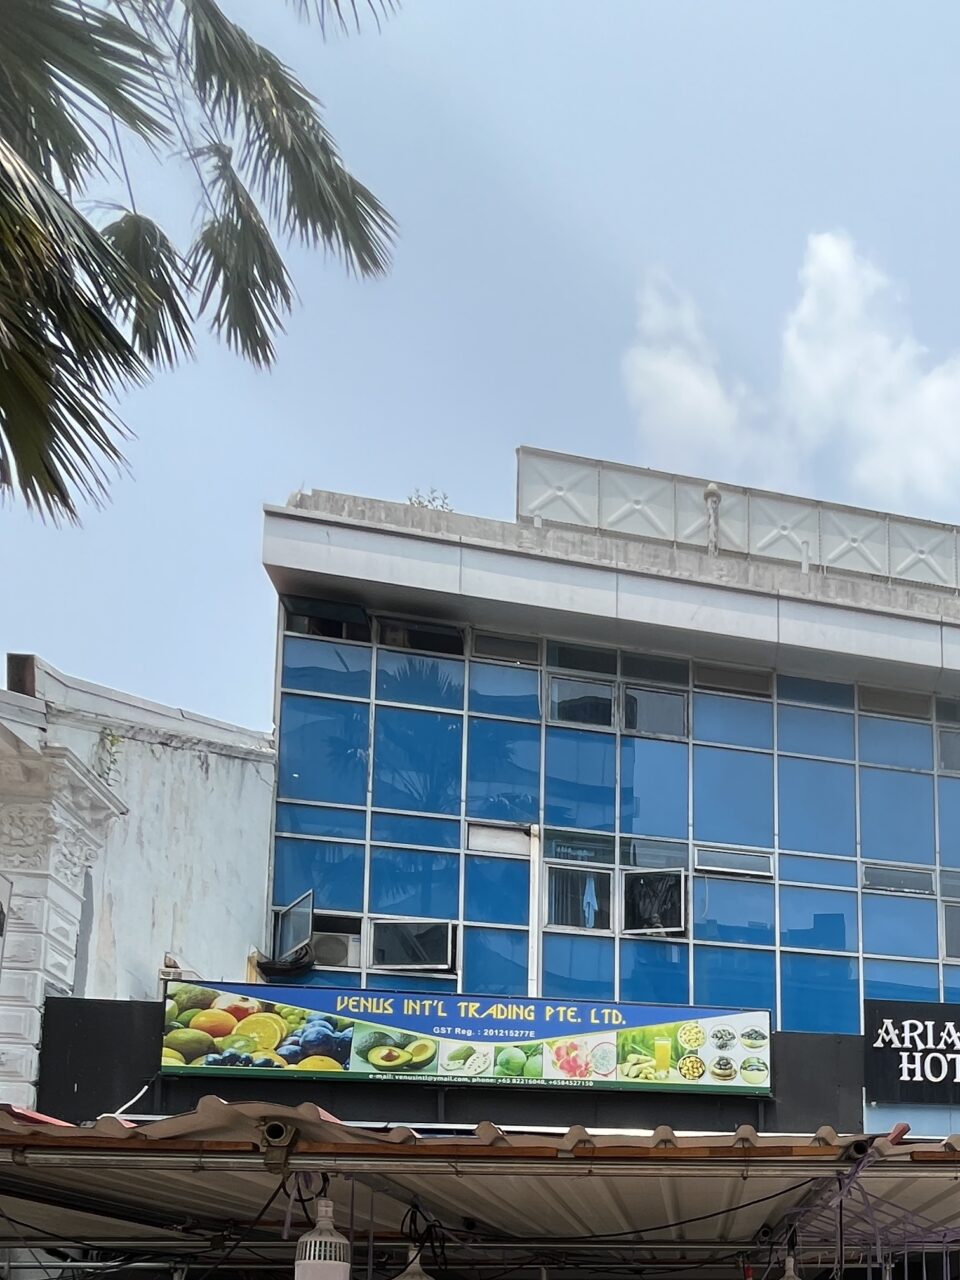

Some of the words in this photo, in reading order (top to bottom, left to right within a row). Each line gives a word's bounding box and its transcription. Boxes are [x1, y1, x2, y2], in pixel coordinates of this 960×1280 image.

[336, 996, 394, 1014] VENUS
[404, 999, 447, 1017] INT'L
[457, 1002, 535, 1021] TRADING
[546, 1005, 582, 1023] PTE.
[590, 1008, 626, 1025] LTD.
[433, 1026, 452, 1034] GST
[484, 1028, 535, 1037] 201215277E
